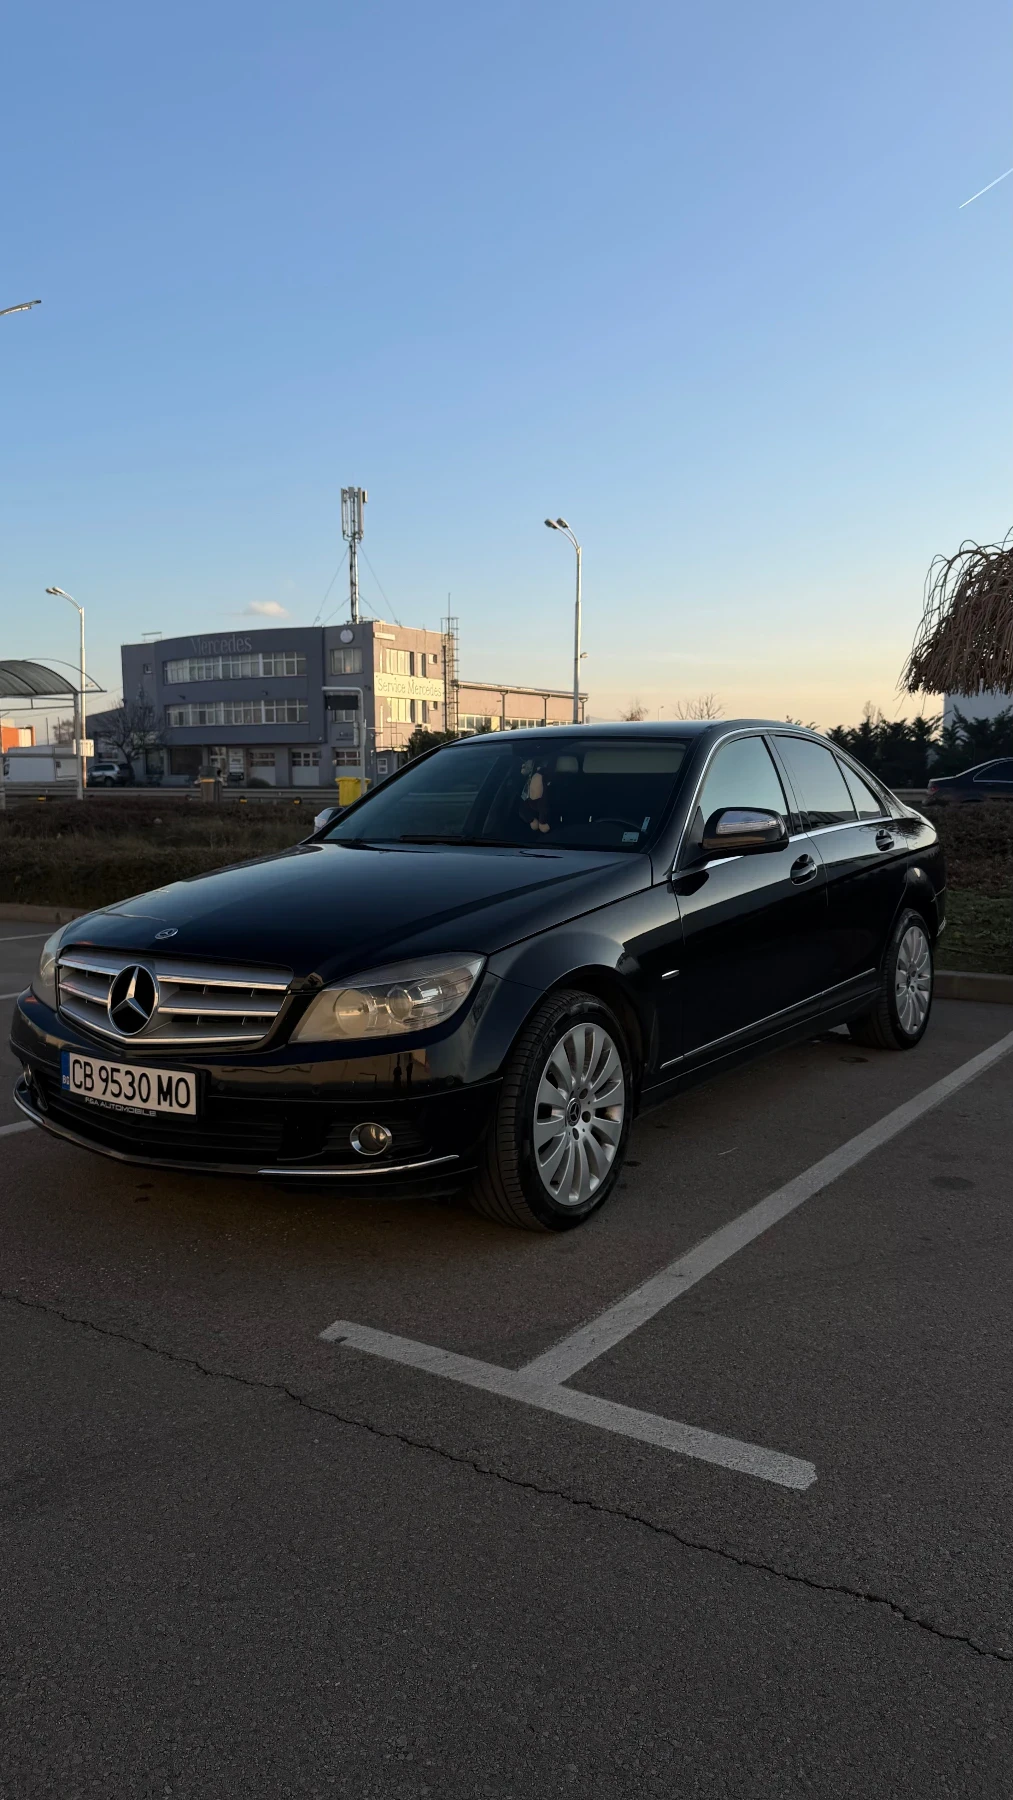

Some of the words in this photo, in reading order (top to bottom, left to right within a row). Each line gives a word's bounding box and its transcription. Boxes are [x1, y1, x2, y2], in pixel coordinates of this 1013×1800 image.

[190, 634, 252, 655] Mercedes
[377, 678, 406, 695] Service
[407, 681, 442, 697] Mercedes
[72, 1059, 95, 1092] CB
[98, 1065, 151, 1103] 9530
[157, 1075, 191, 1109] MO
